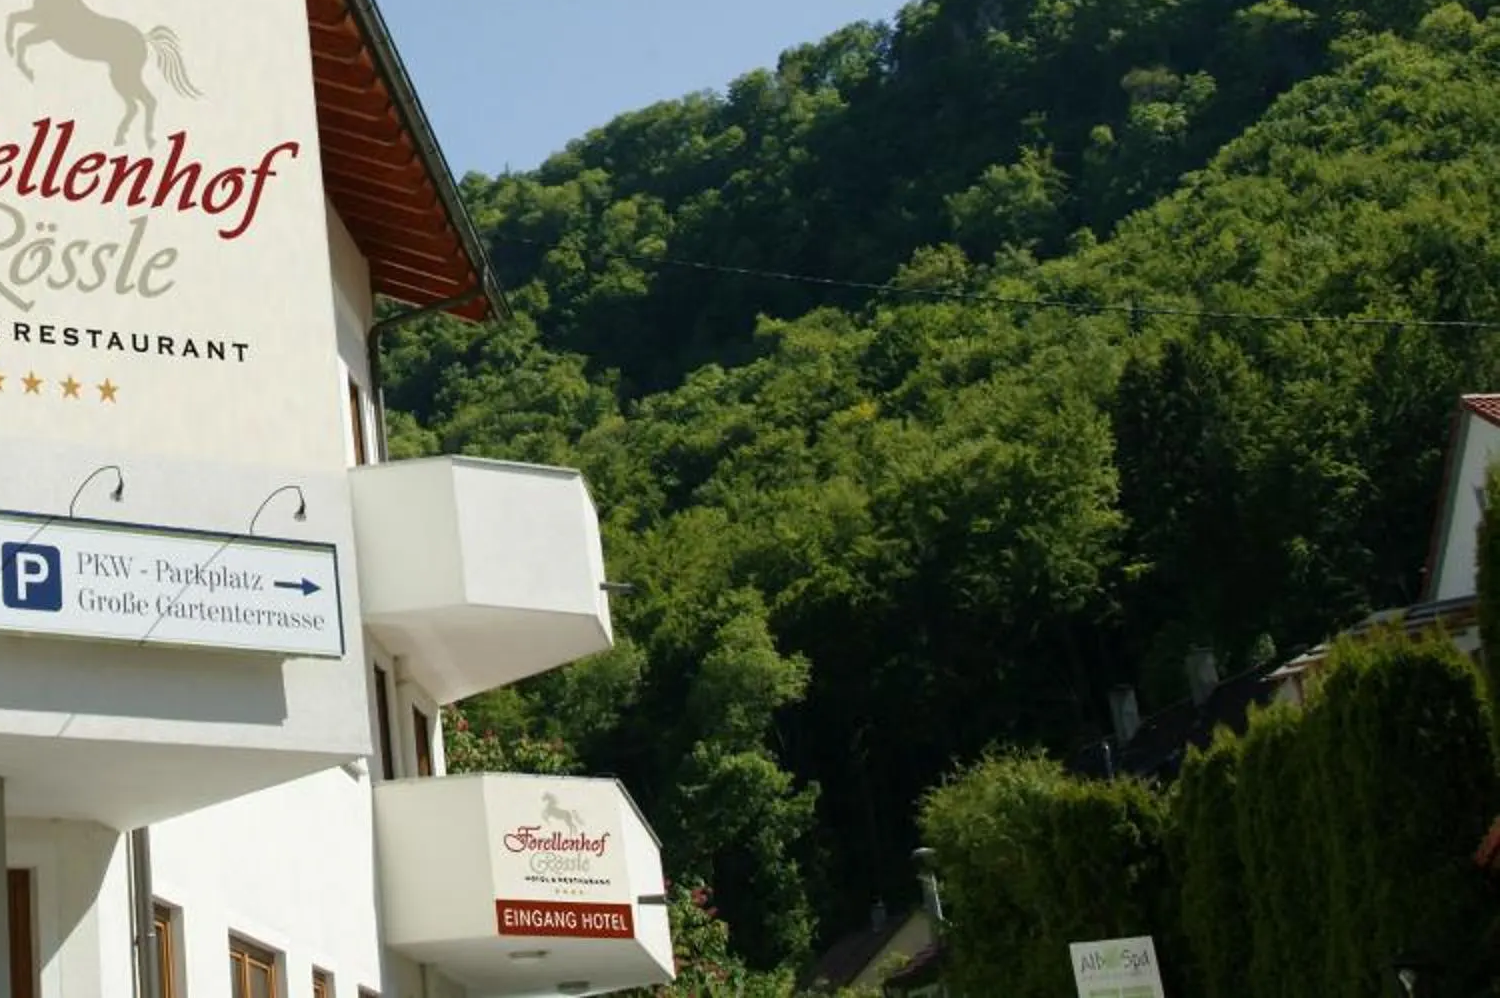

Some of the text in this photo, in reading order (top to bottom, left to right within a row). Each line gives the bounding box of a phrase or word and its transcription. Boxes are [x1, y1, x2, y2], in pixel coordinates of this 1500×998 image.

[13, 322, 250, 363] RESTAURANT
[15, 551, 50, 601] P
[76, 551, 133, 579] PKW
[156, 559, 265, 594] Parkplatz
[78, 587, 326, 631] Große Gartenterrasse
[503, 825, 611, 858] Forellenhof
[503, 908, 628, 932] EINGANG HOTEL
